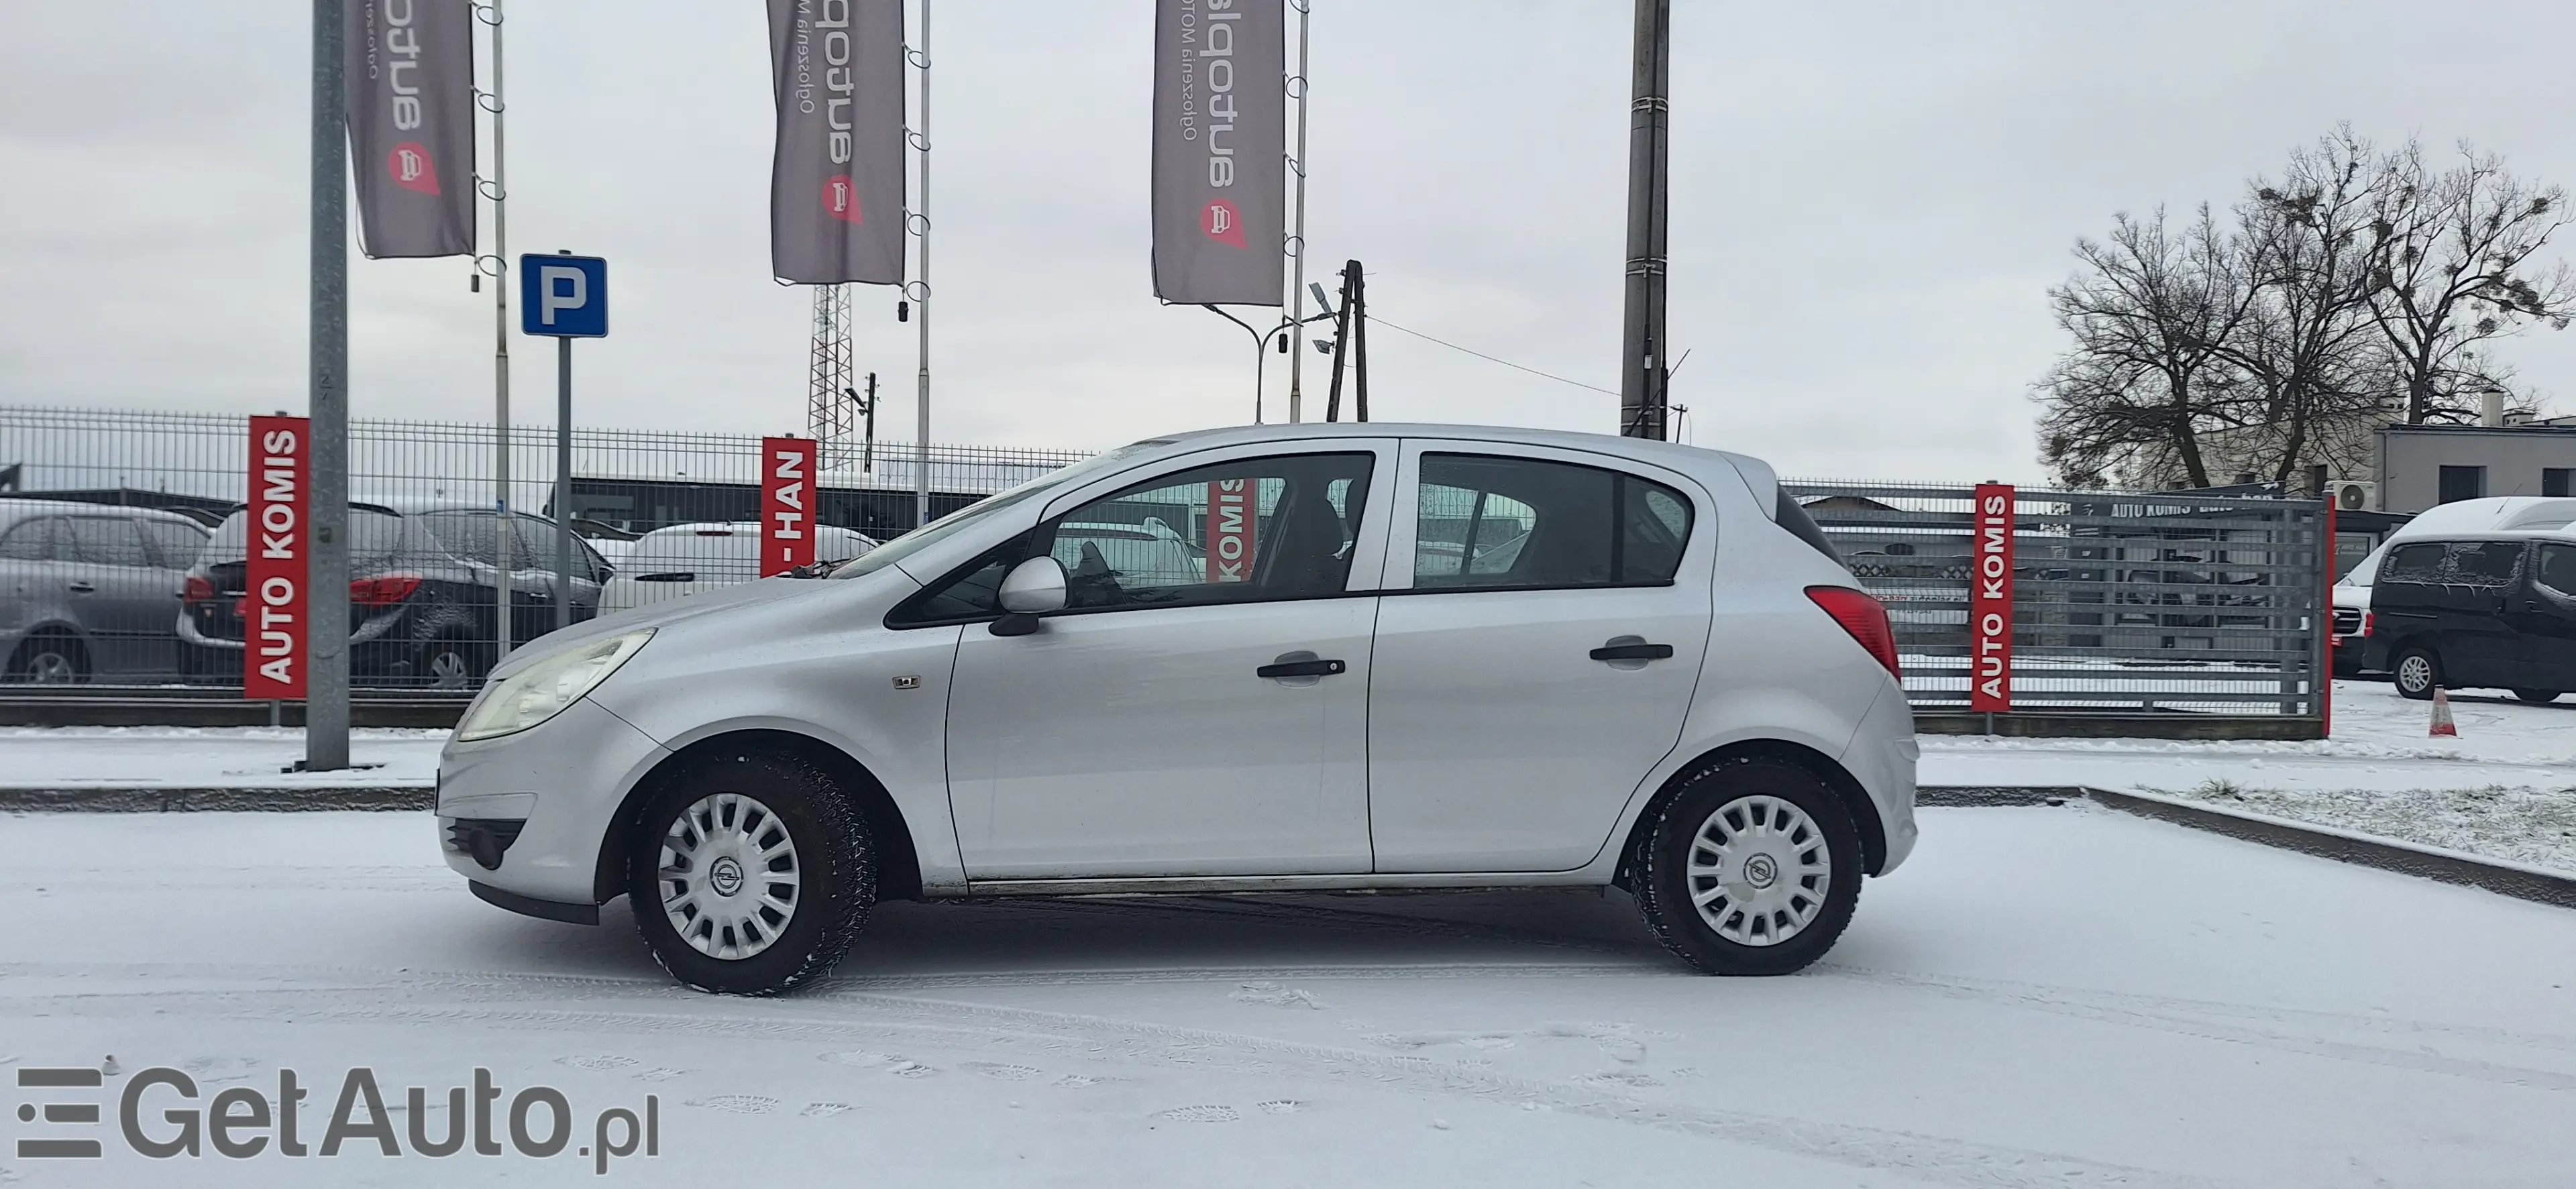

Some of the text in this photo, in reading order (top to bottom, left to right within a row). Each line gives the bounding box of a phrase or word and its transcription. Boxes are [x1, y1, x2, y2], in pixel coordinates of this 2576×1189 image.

[541, 266, 586, 325] P
[260, 429, 297, 685] AUTO KOMIS
[1219, 479, 1244, 582] KOMIS
[1981, 496, 2006, 699] AUTO KOMIS
